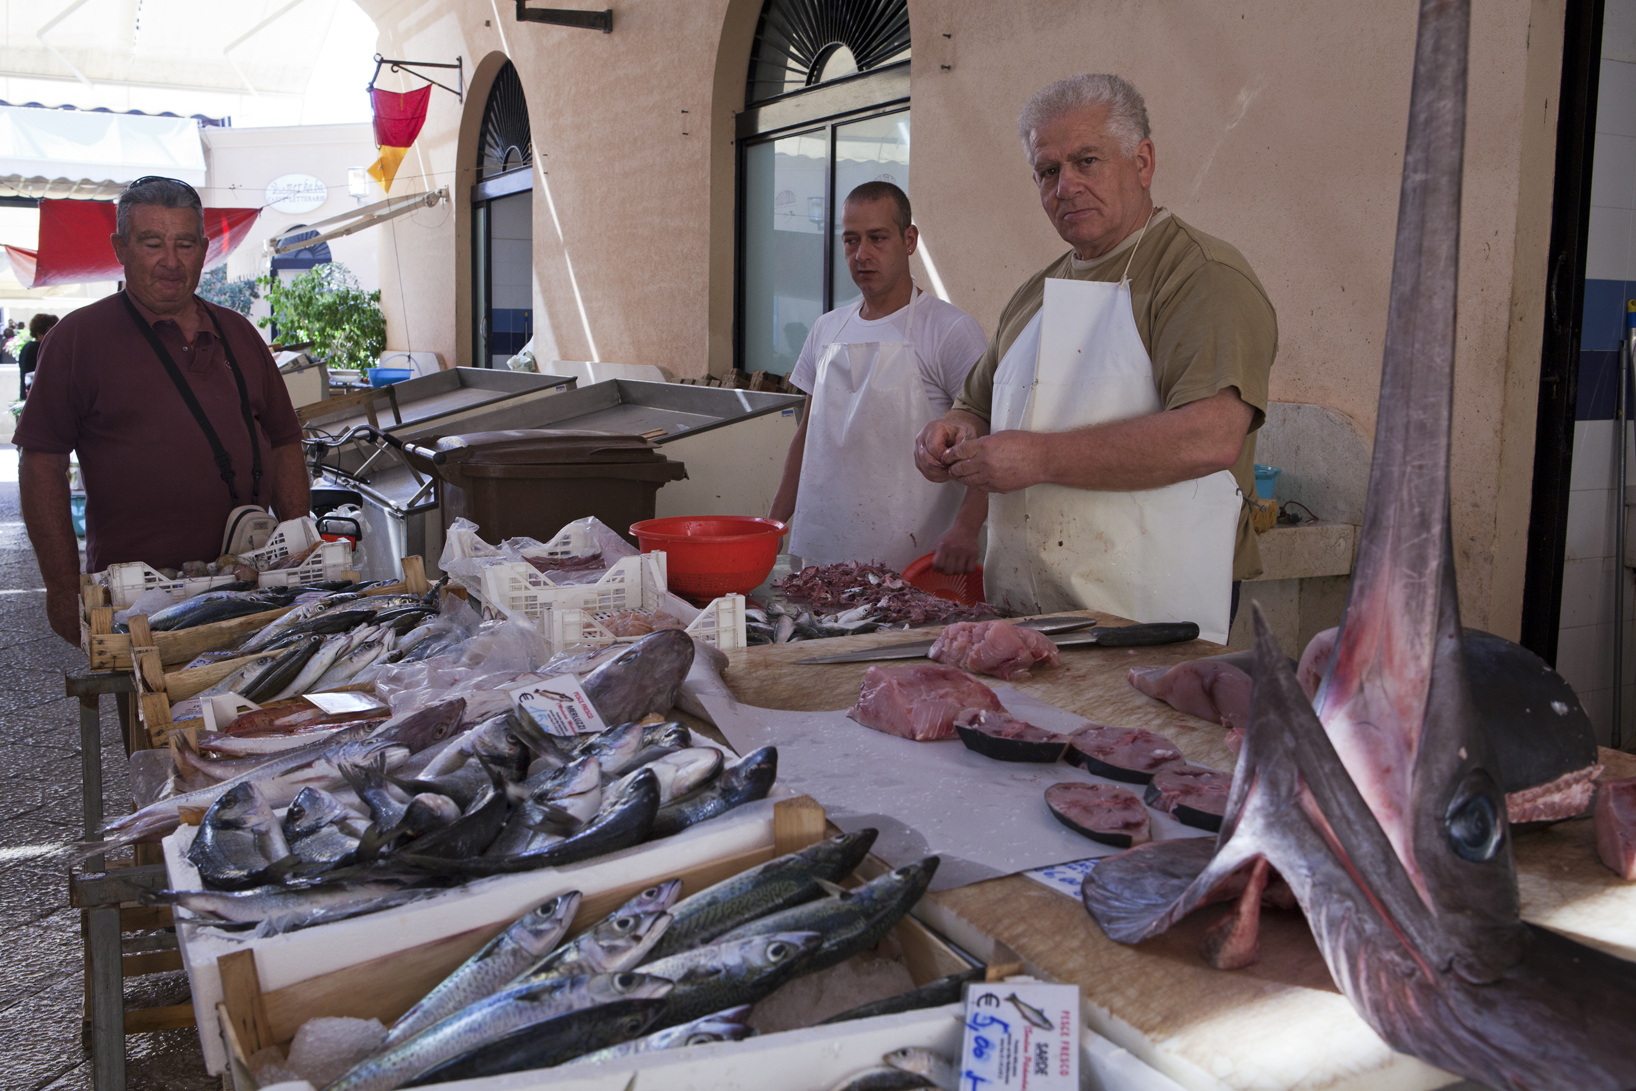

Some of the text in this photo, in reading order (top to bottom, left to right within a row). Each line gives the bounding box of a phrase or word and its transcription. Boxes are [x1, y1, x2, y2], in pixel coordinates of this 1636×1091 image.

[519, 692, 534, 703] €
[566, 705, 586, 730] MERLUZZI
[976, 991, 1000, 1008] €
[1059, 1010, 1070, 1076] PESCE FRESCO
[1035, 1042, 1049, 1076] SARDE
